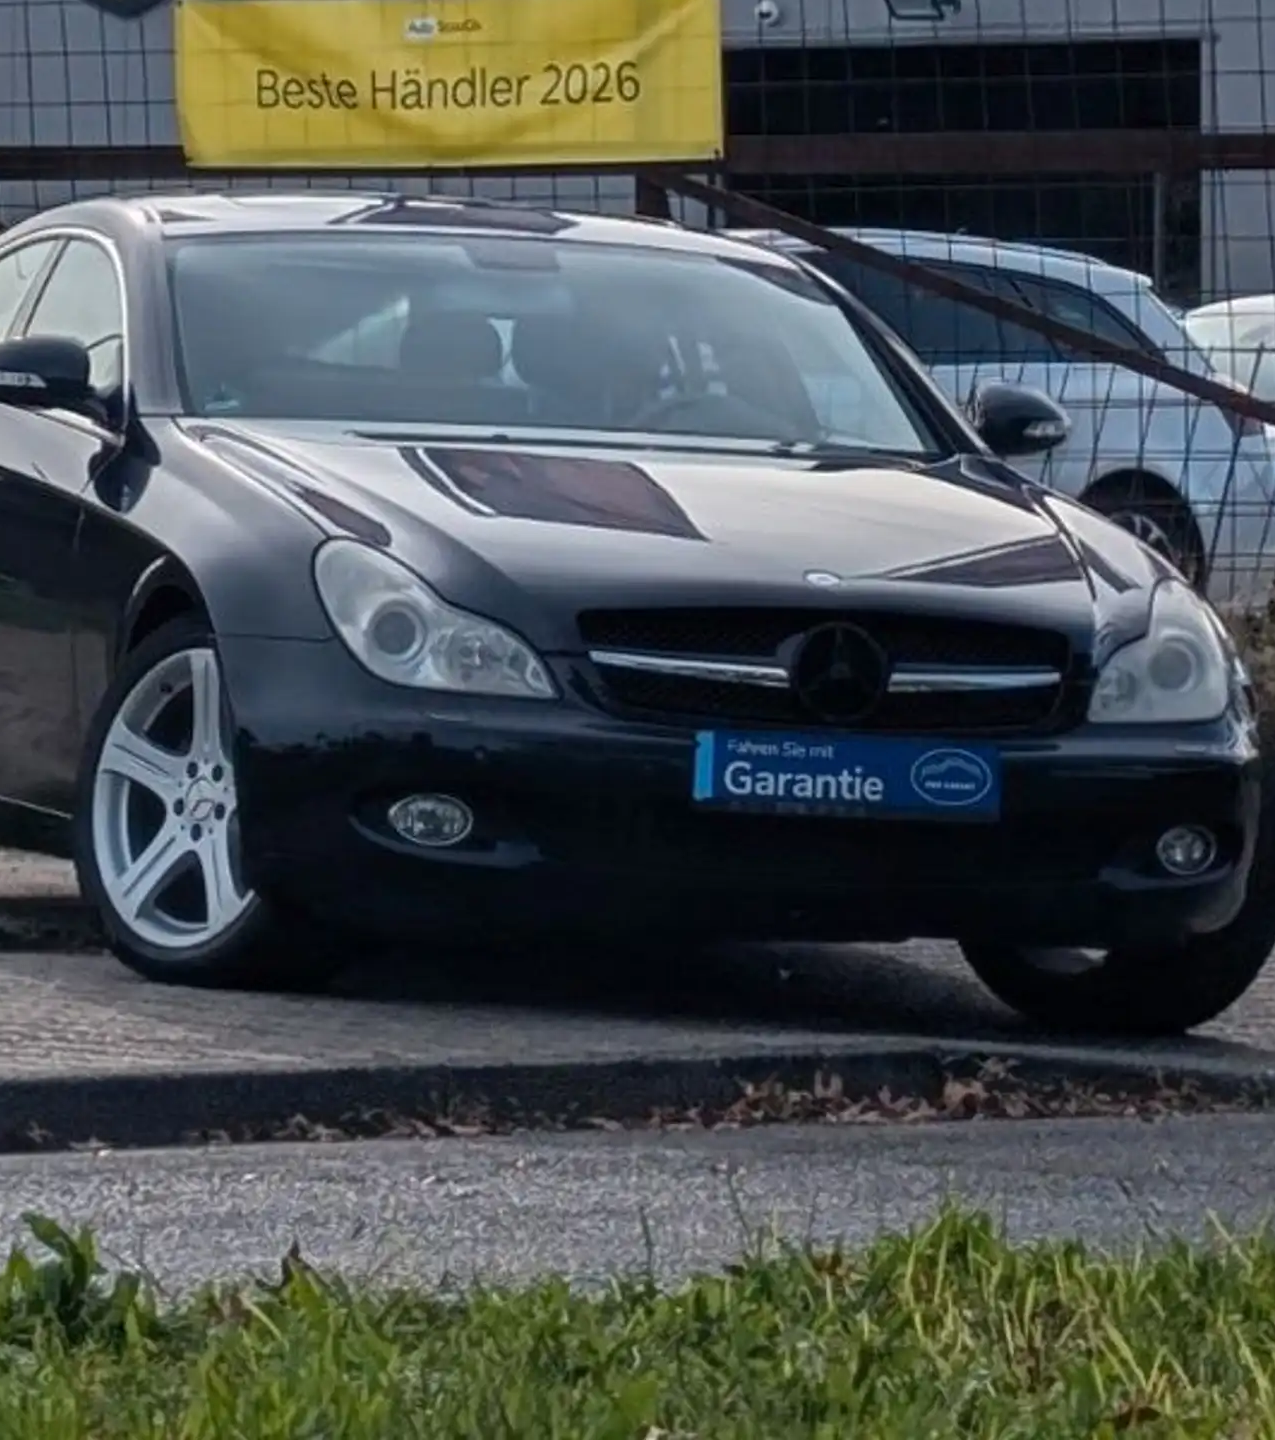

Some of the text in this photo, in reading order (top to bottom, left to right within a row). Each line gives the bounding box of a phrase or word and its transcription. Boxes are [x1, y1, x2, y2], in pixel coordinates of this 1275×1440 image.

[256, 61, 641, 110] Beste Händler 2026
[726, 738, 836, 760] Fahren Sie mit
[724, 760, 885, 801] Garantie
